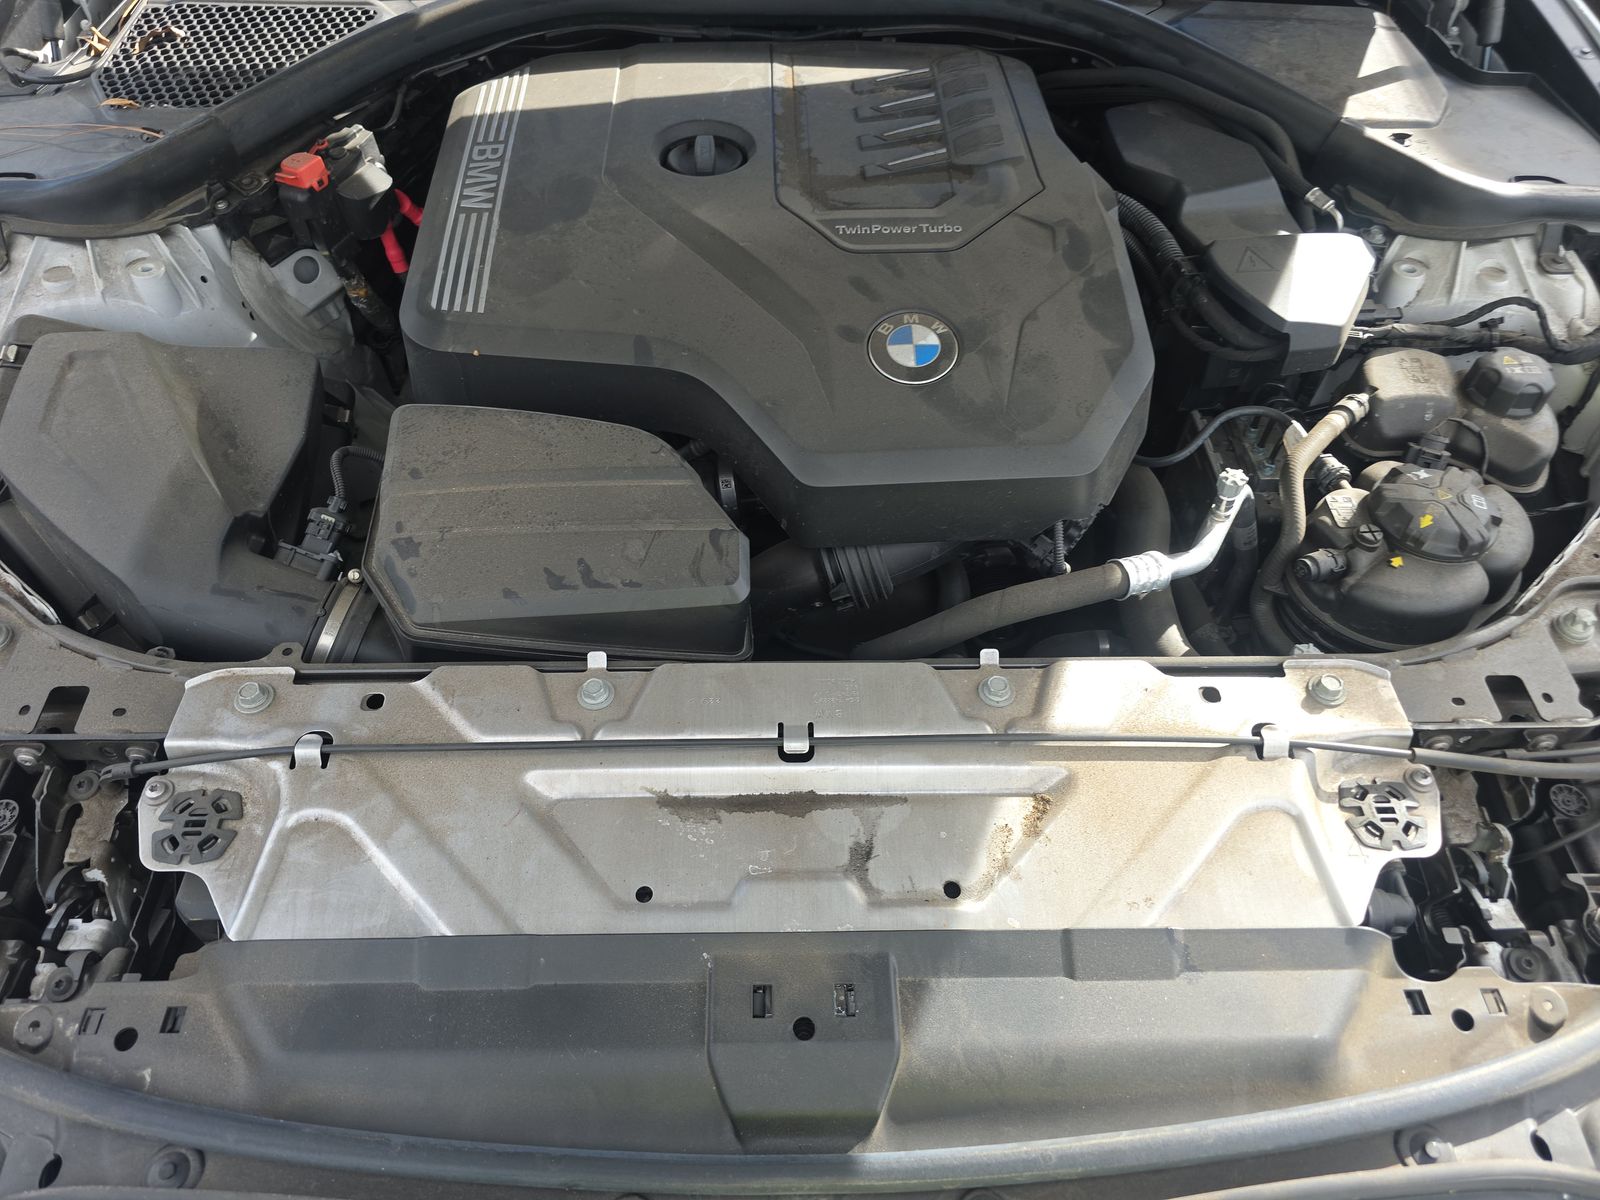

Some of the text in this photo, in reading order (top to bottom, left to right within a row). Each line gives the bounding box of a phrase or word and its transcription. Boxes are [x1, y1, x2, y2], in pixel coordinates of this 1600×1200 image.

[460, 144, 505, 209] BMW
[919, 223, 963, 234] Turbo
[877, 313, 948, 336] BMW
